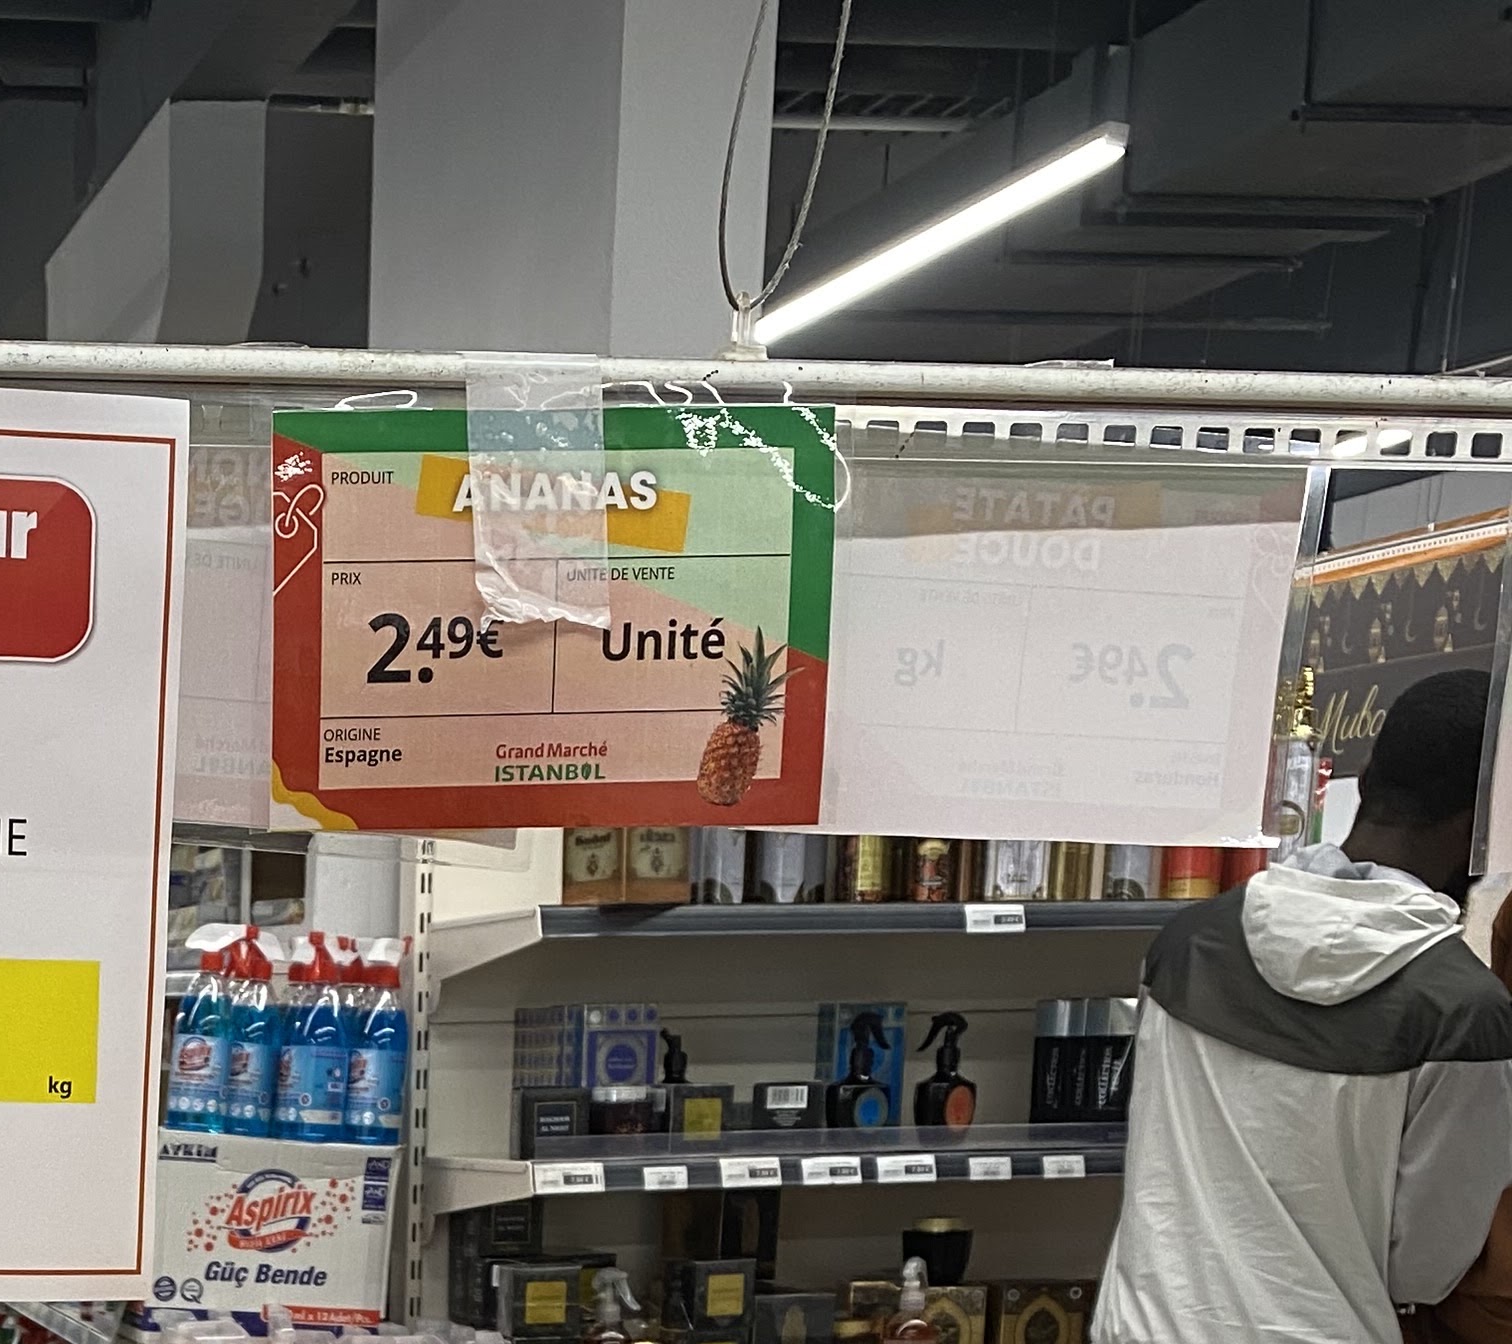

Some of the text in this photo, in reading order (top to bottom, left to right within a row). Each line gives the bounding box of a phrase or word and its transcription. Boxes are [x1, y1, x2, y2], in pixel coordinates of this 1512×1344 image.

[331, 470, 393, 486] PRODUIT
[453, 470, 658, 513] ANANAS
[331, 571, 362, 585] PRIX
[611, 567, 628, 581] DE
[632, 566, 675, 581] VENTE
[366, 612, 504, 685] 2.49€
[601, 616, 725, 661] Unité
[1314, 684, 1386, 754] Muba
[323, 727, 381, 742] ORIGINE
[324, 745, 403, 768] Espagne
[496, 740, 608, 760] Grand Marché
[494, 762, 606, 783] ISTANBUL
[48, 1075, 73, 1099] kg
[225, 1187, 317, 1232] Aspirix
[205, 1261, 328, 1288] Güç Bende
